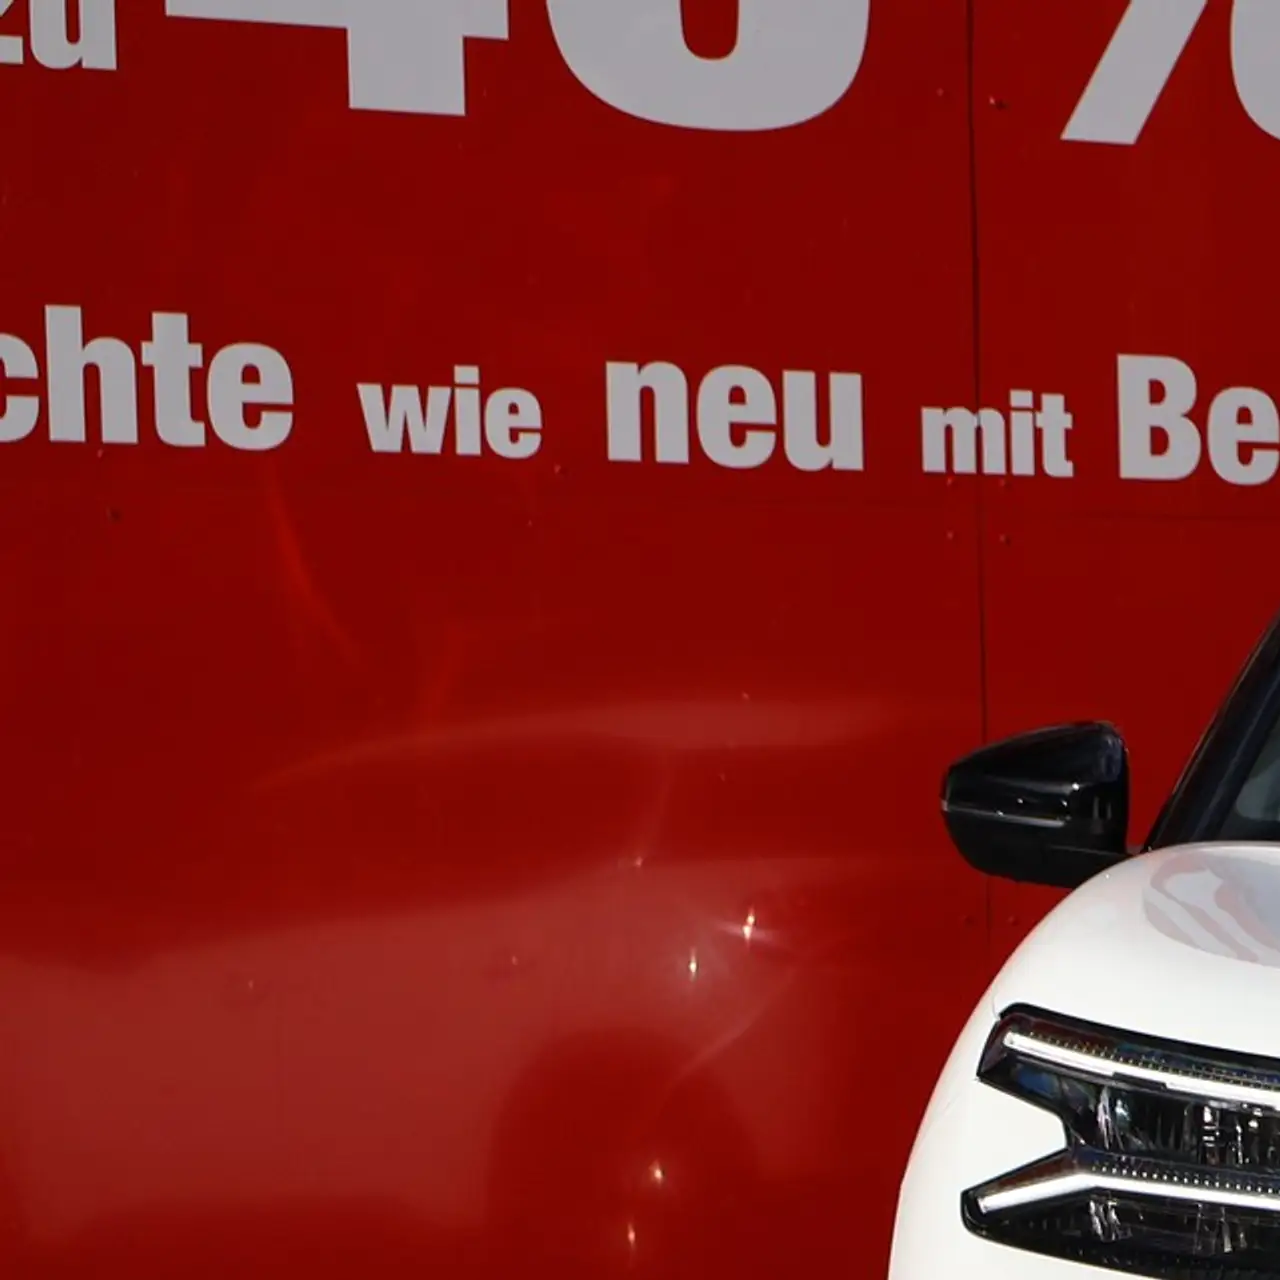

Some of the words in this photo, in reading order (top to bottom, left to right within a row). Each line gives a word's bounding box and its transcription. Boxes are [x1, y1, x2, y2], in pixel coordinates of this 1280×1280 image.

[356, 365, 542, 459] wie
[605, 361, 864, 471] neu
[921, 389, 1074, 478] mit
